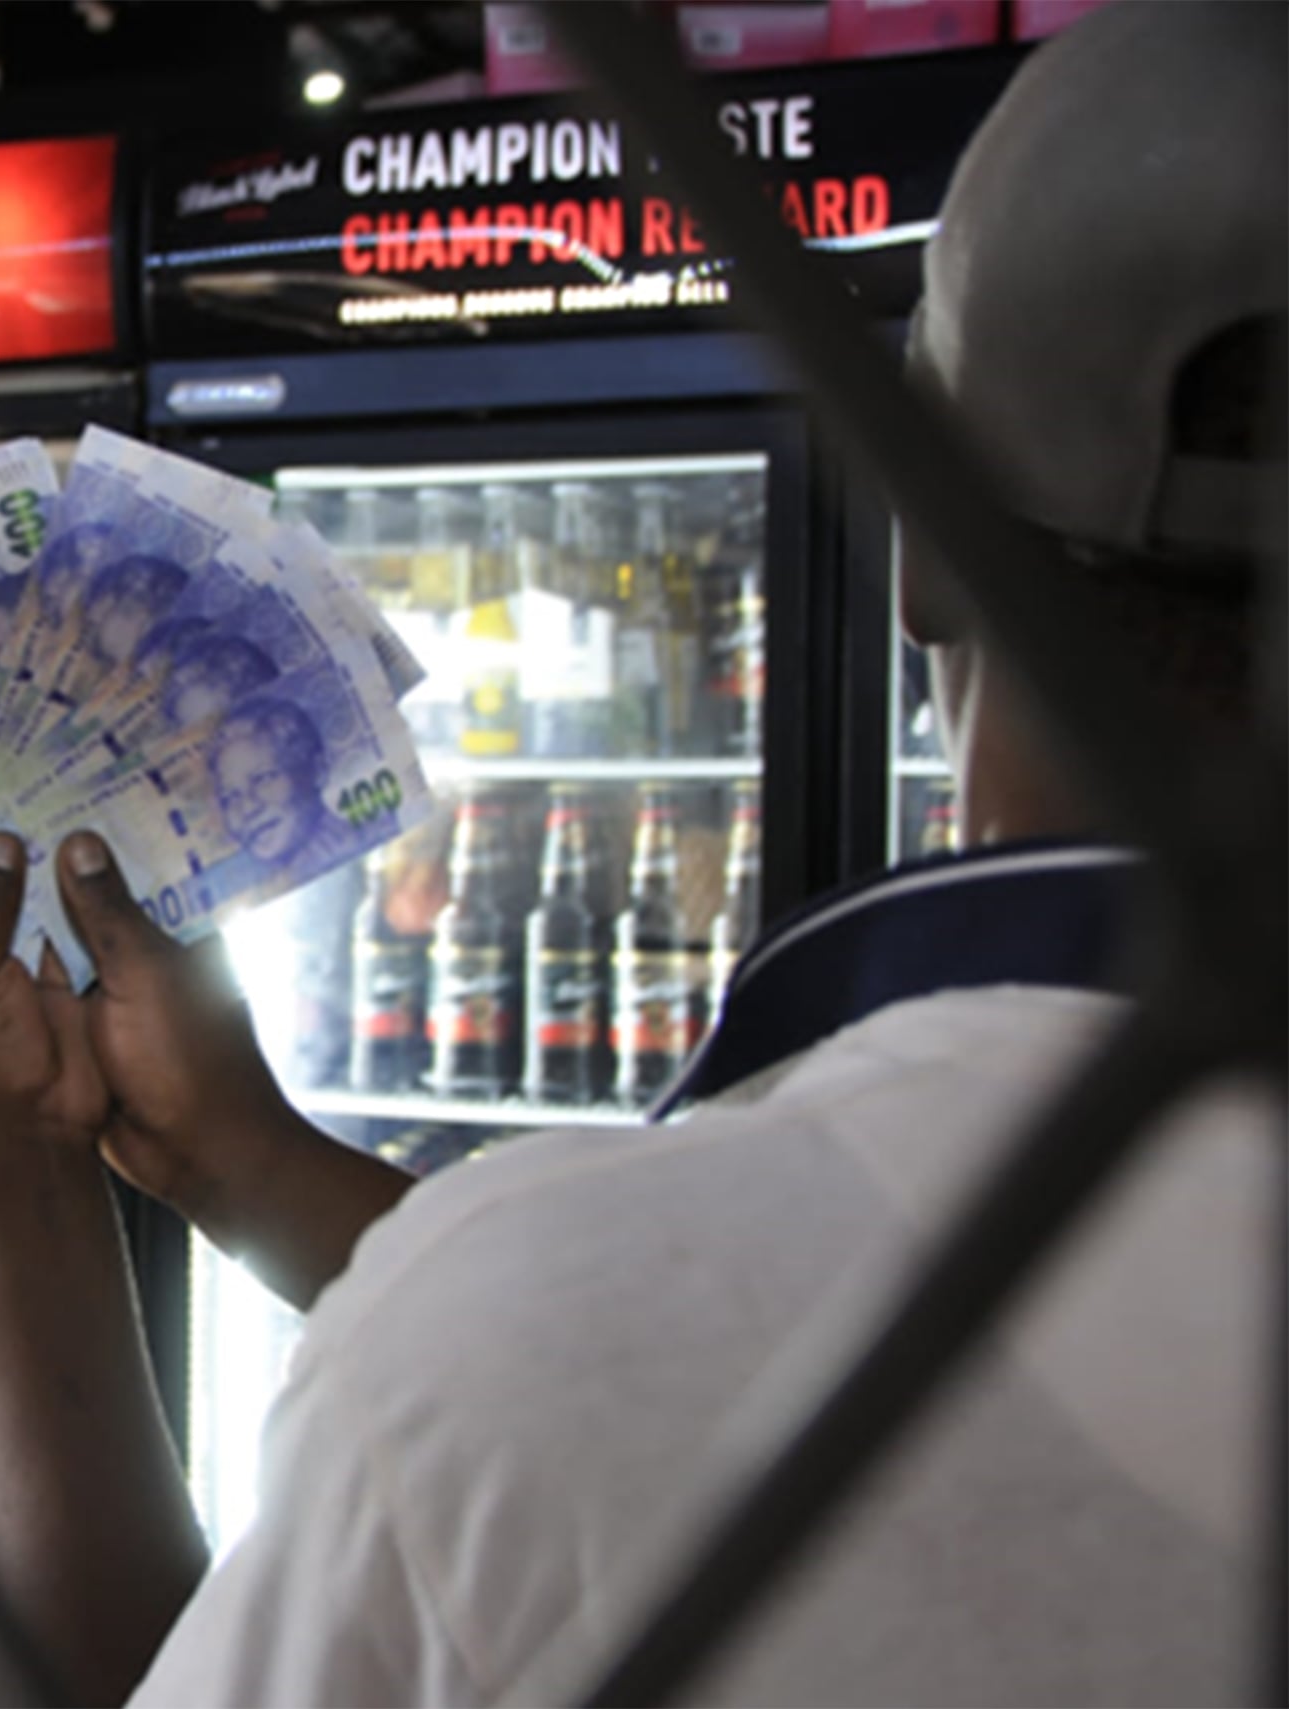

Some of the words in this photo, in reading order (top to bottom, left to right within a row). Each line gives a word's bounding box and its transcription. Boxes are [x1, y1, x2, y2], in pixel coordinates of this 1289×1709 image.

[343, 121, 621, 195] CHAMPION
[341, 197, 623, 276] CHAMPION
[641, 174, 889, 256] REARD
[338, 768, 403, 828] 100
